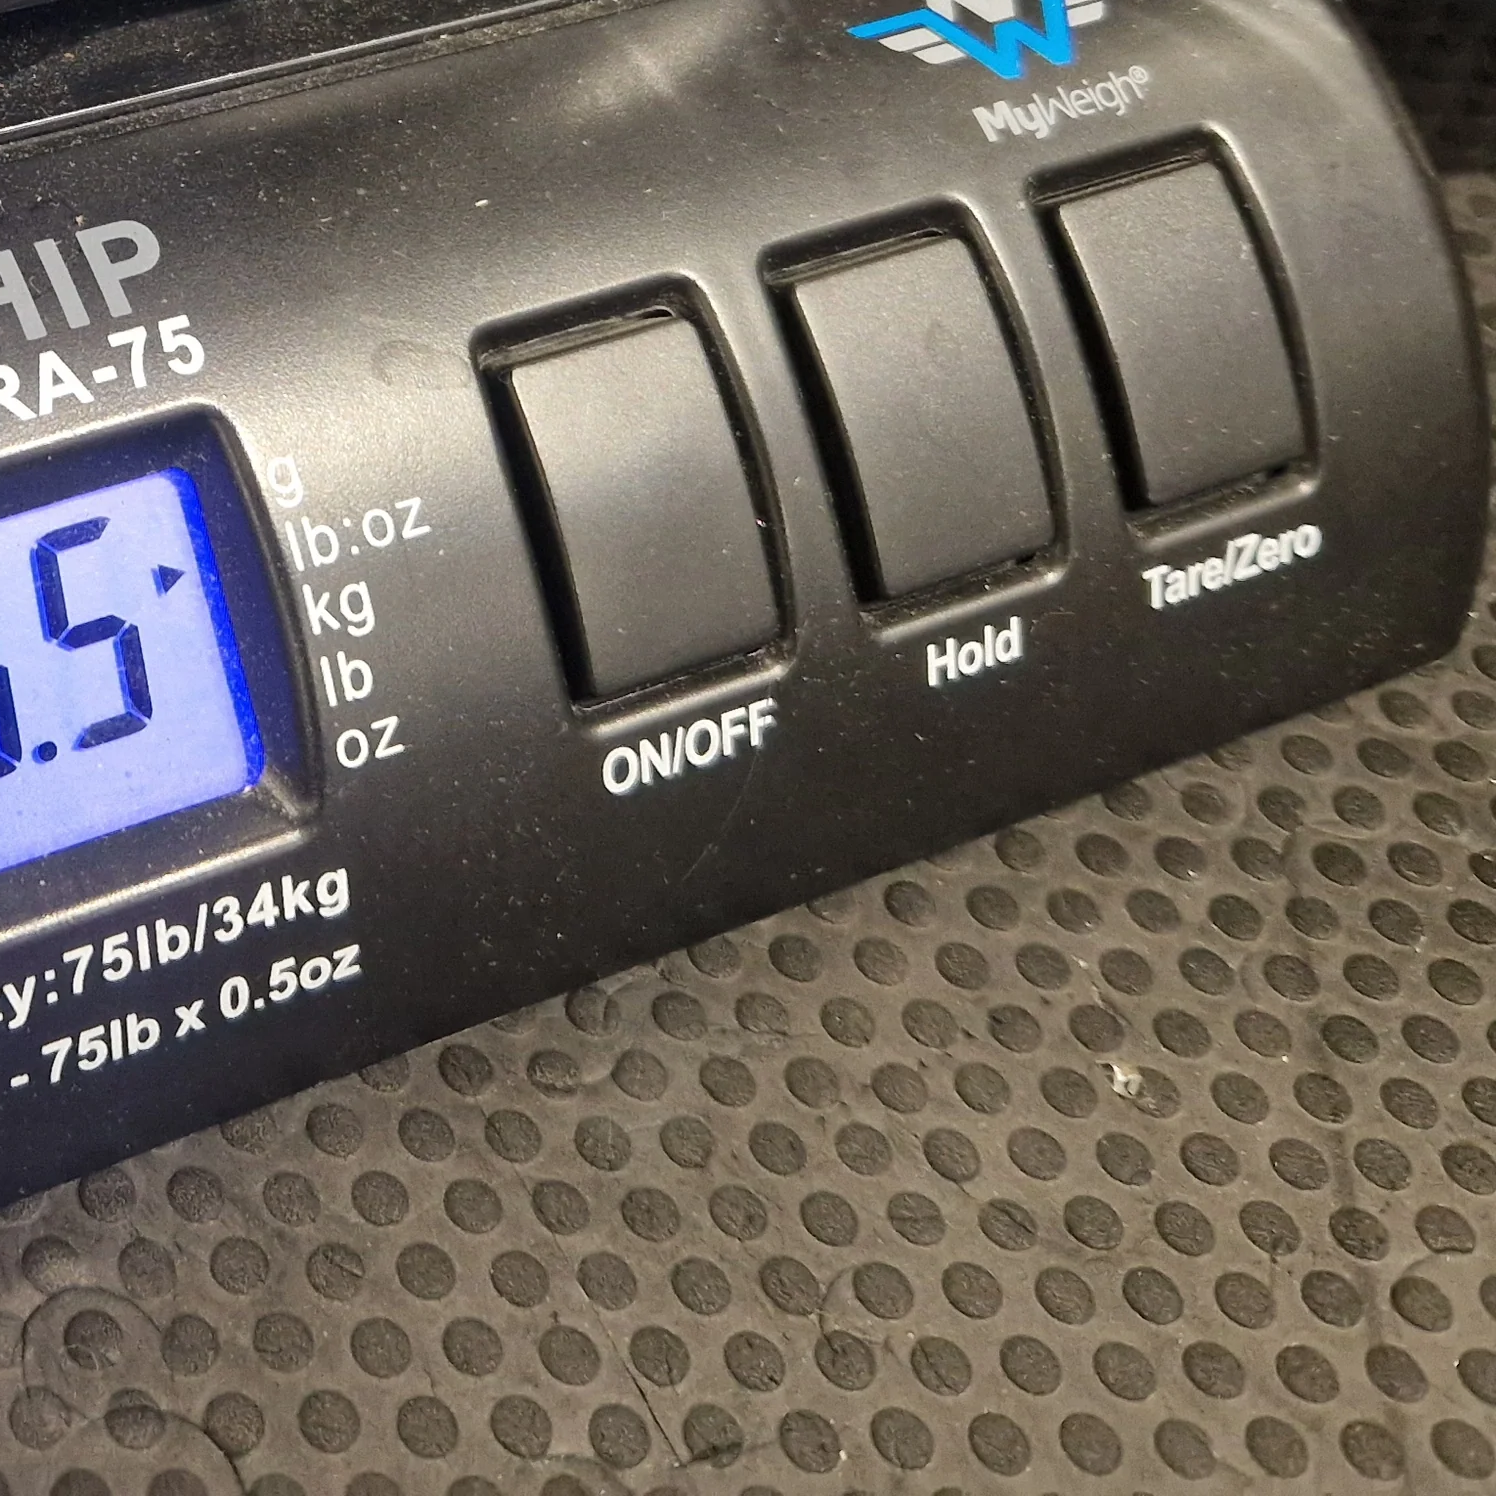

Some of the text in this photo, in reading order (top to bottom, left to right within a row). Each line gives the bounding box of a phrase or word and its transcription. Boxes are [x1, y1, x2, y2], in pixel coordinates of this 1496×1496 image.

[266, 455, 304, 508] g
[284, 496, 432, 572] lb:oz
[1142, 522, 1324, 611] Tare/Zero
[302, 580, 376, 637] kg
[319, 650, 374, 707] lb
[925, 615, 1024, 688] Hold
[335, 714, 406, 769] oz
[601, 697, 778, 796] ON/OFF
[40, 1013, 162, 1088] 75lb
[173, 1003, 208, 1038] x
[218, 943, 363, 1020] 0.5oz
